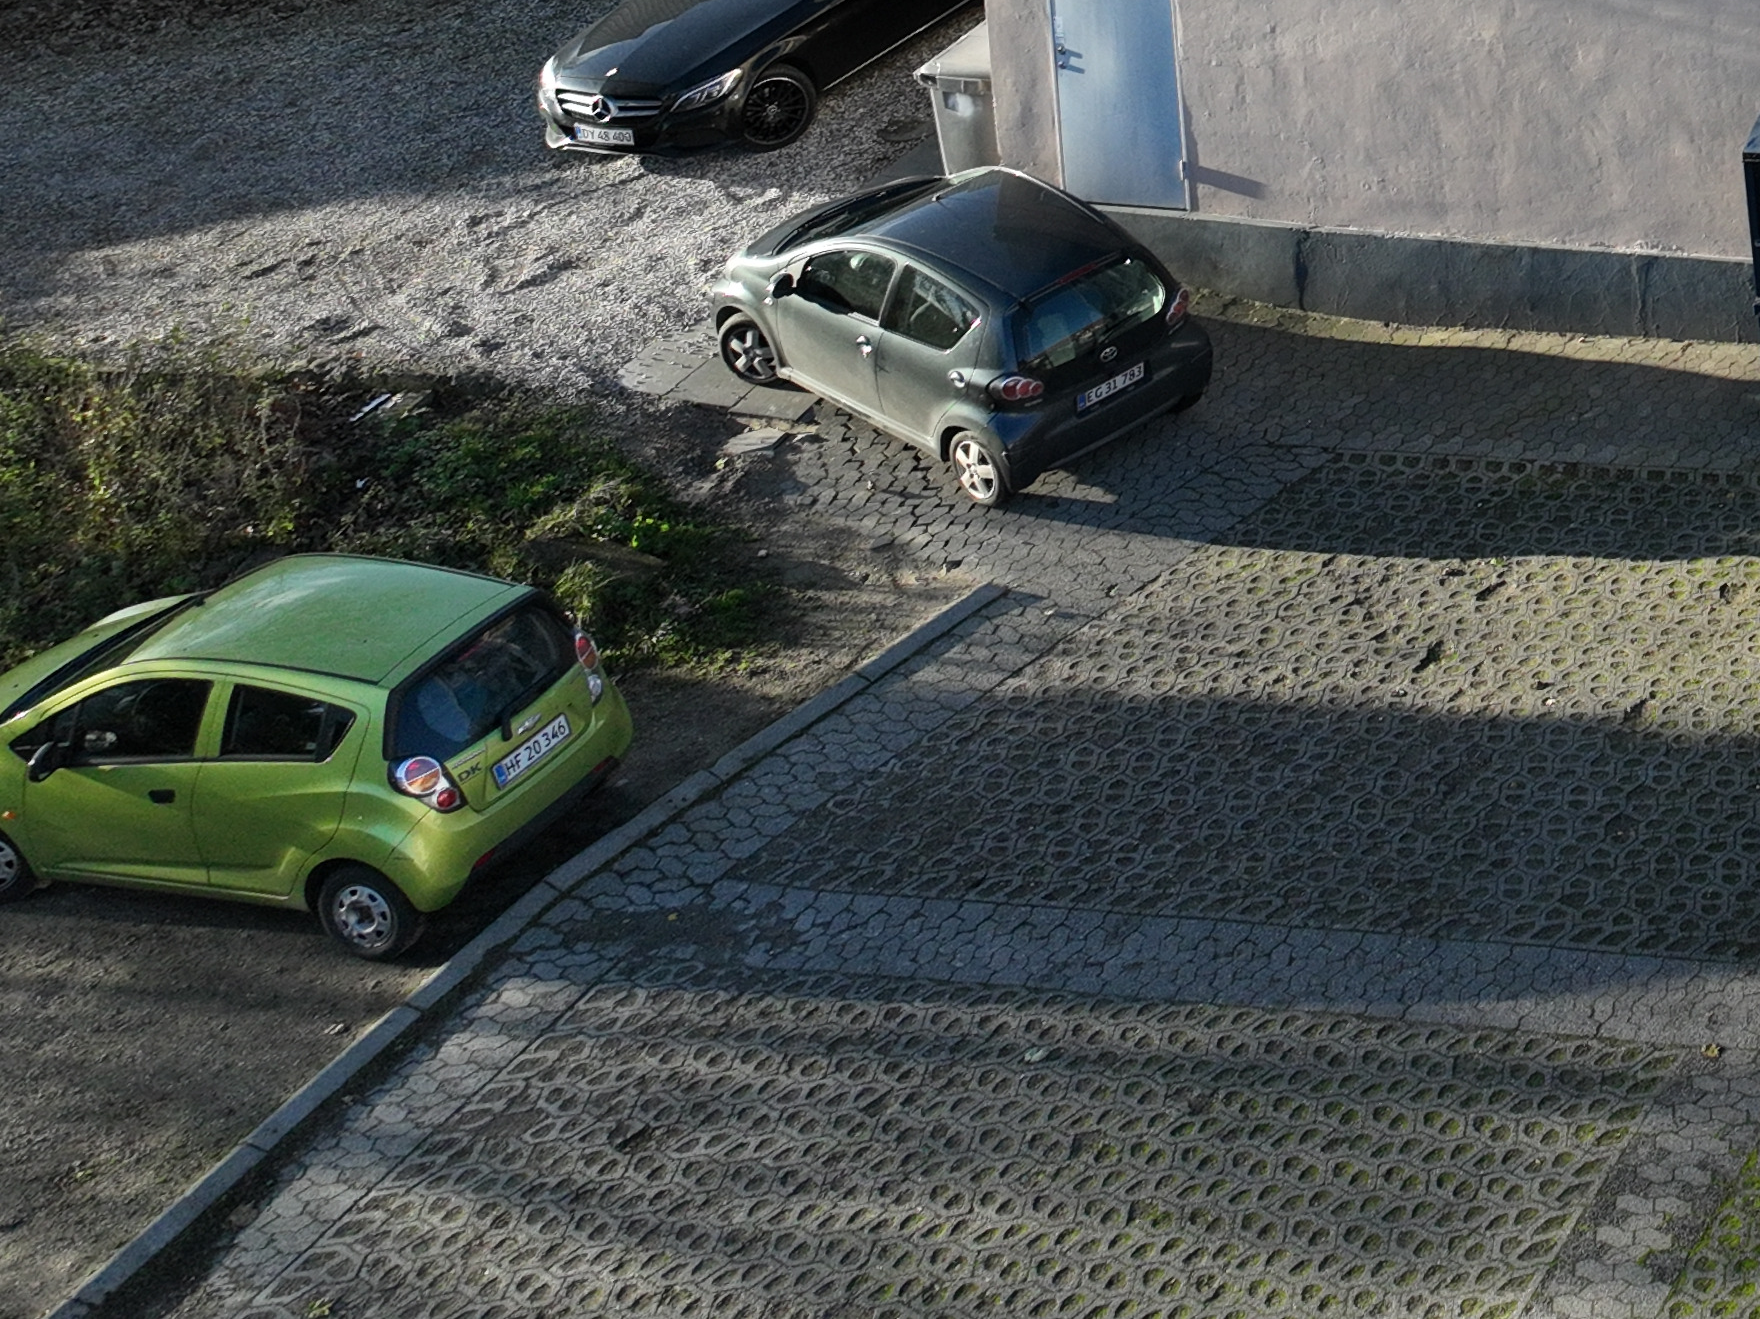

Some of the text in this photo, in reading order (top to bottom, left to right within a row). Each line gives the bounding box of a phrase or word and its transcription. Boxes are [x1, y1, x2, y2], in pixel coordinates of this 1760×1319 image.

[1086, 365, 1143, 403] EG 31 783
[504, 751, 522, 777] HF
[523, 742, 542, 762] 20
[541, 720, 567, 749] 346
[457, 761, 482, 783] DK
